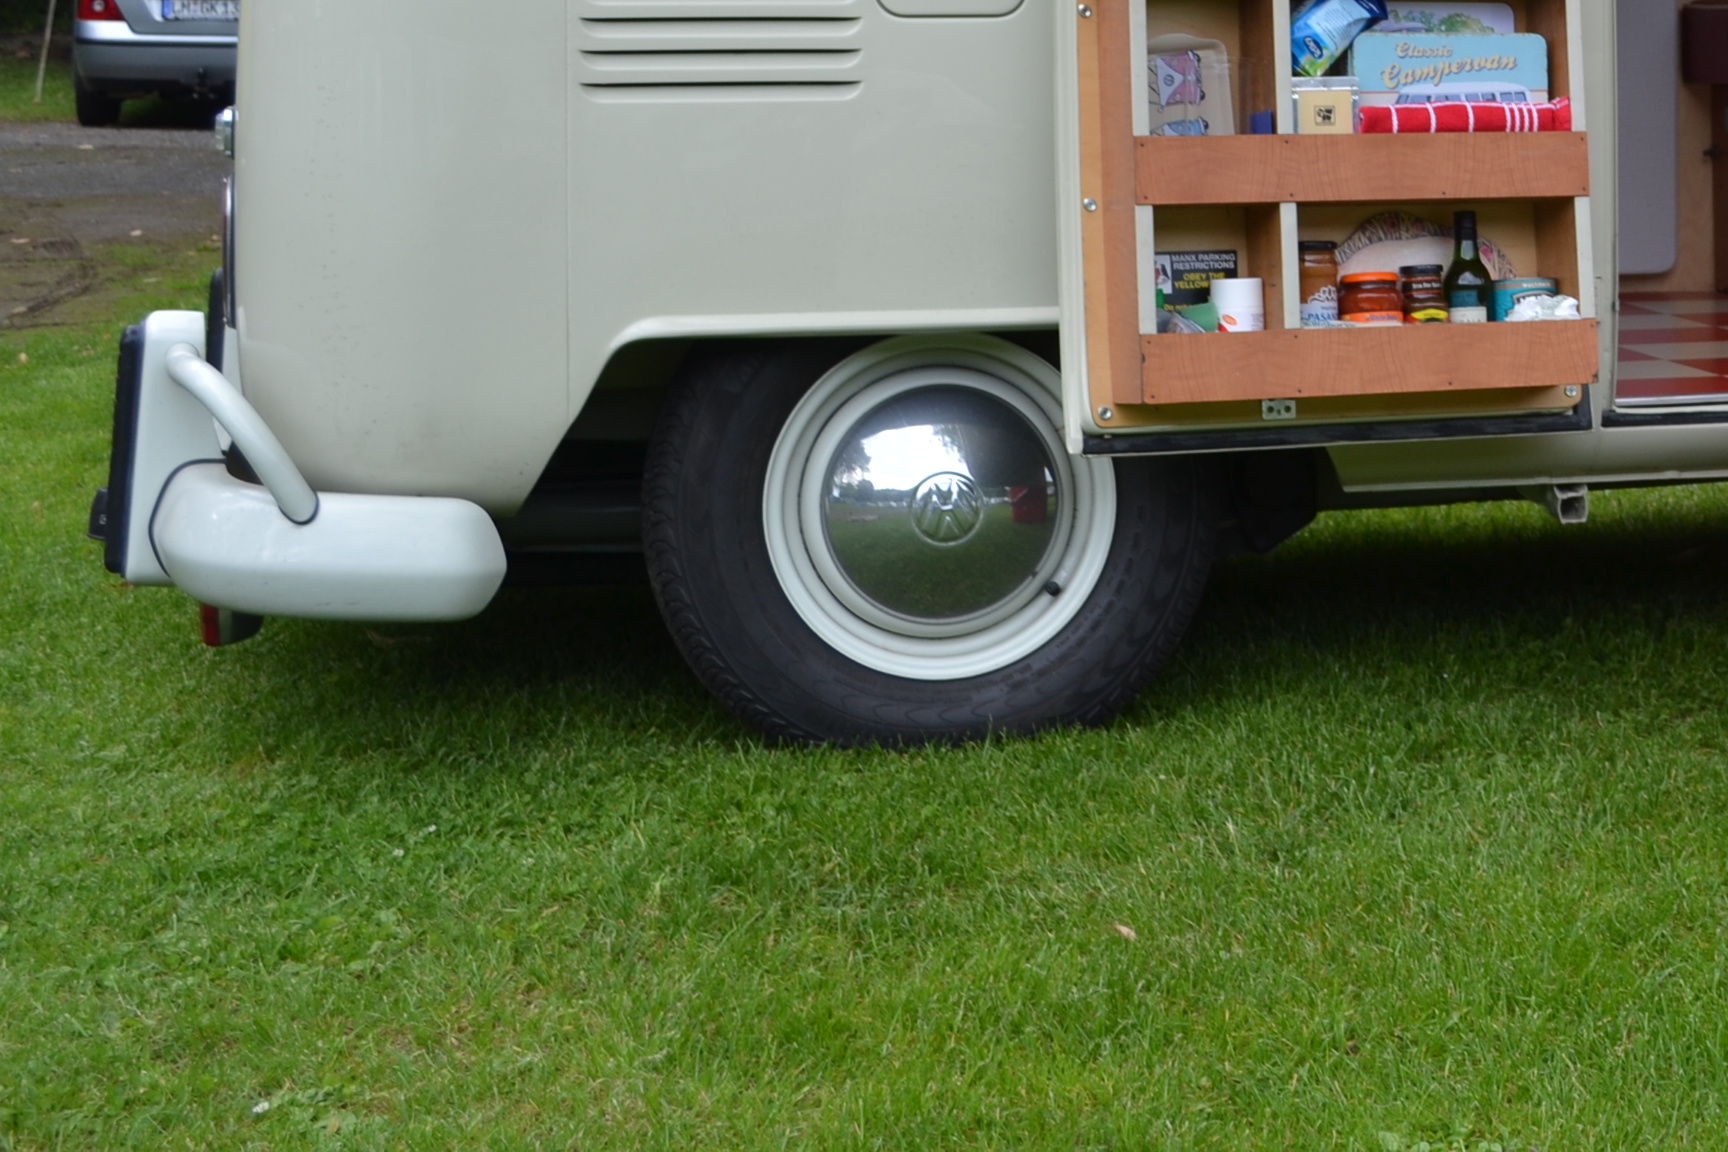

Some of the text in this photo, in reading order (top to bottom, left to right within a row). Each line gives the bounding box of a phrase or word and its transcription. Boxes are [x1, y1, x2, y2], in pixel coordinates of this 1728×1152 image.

[1395, 40, 1453, 59] Classic
[1380, 54, 1518, 89] Campervan
[1171, 253, 1236, 263] MANX PARKING
[1173, 261, 1235, 270] RESTRICTIONS
[1183, 272, 1207, 281] OBEY
[1174, 280, 1210, 289] YELLOW
